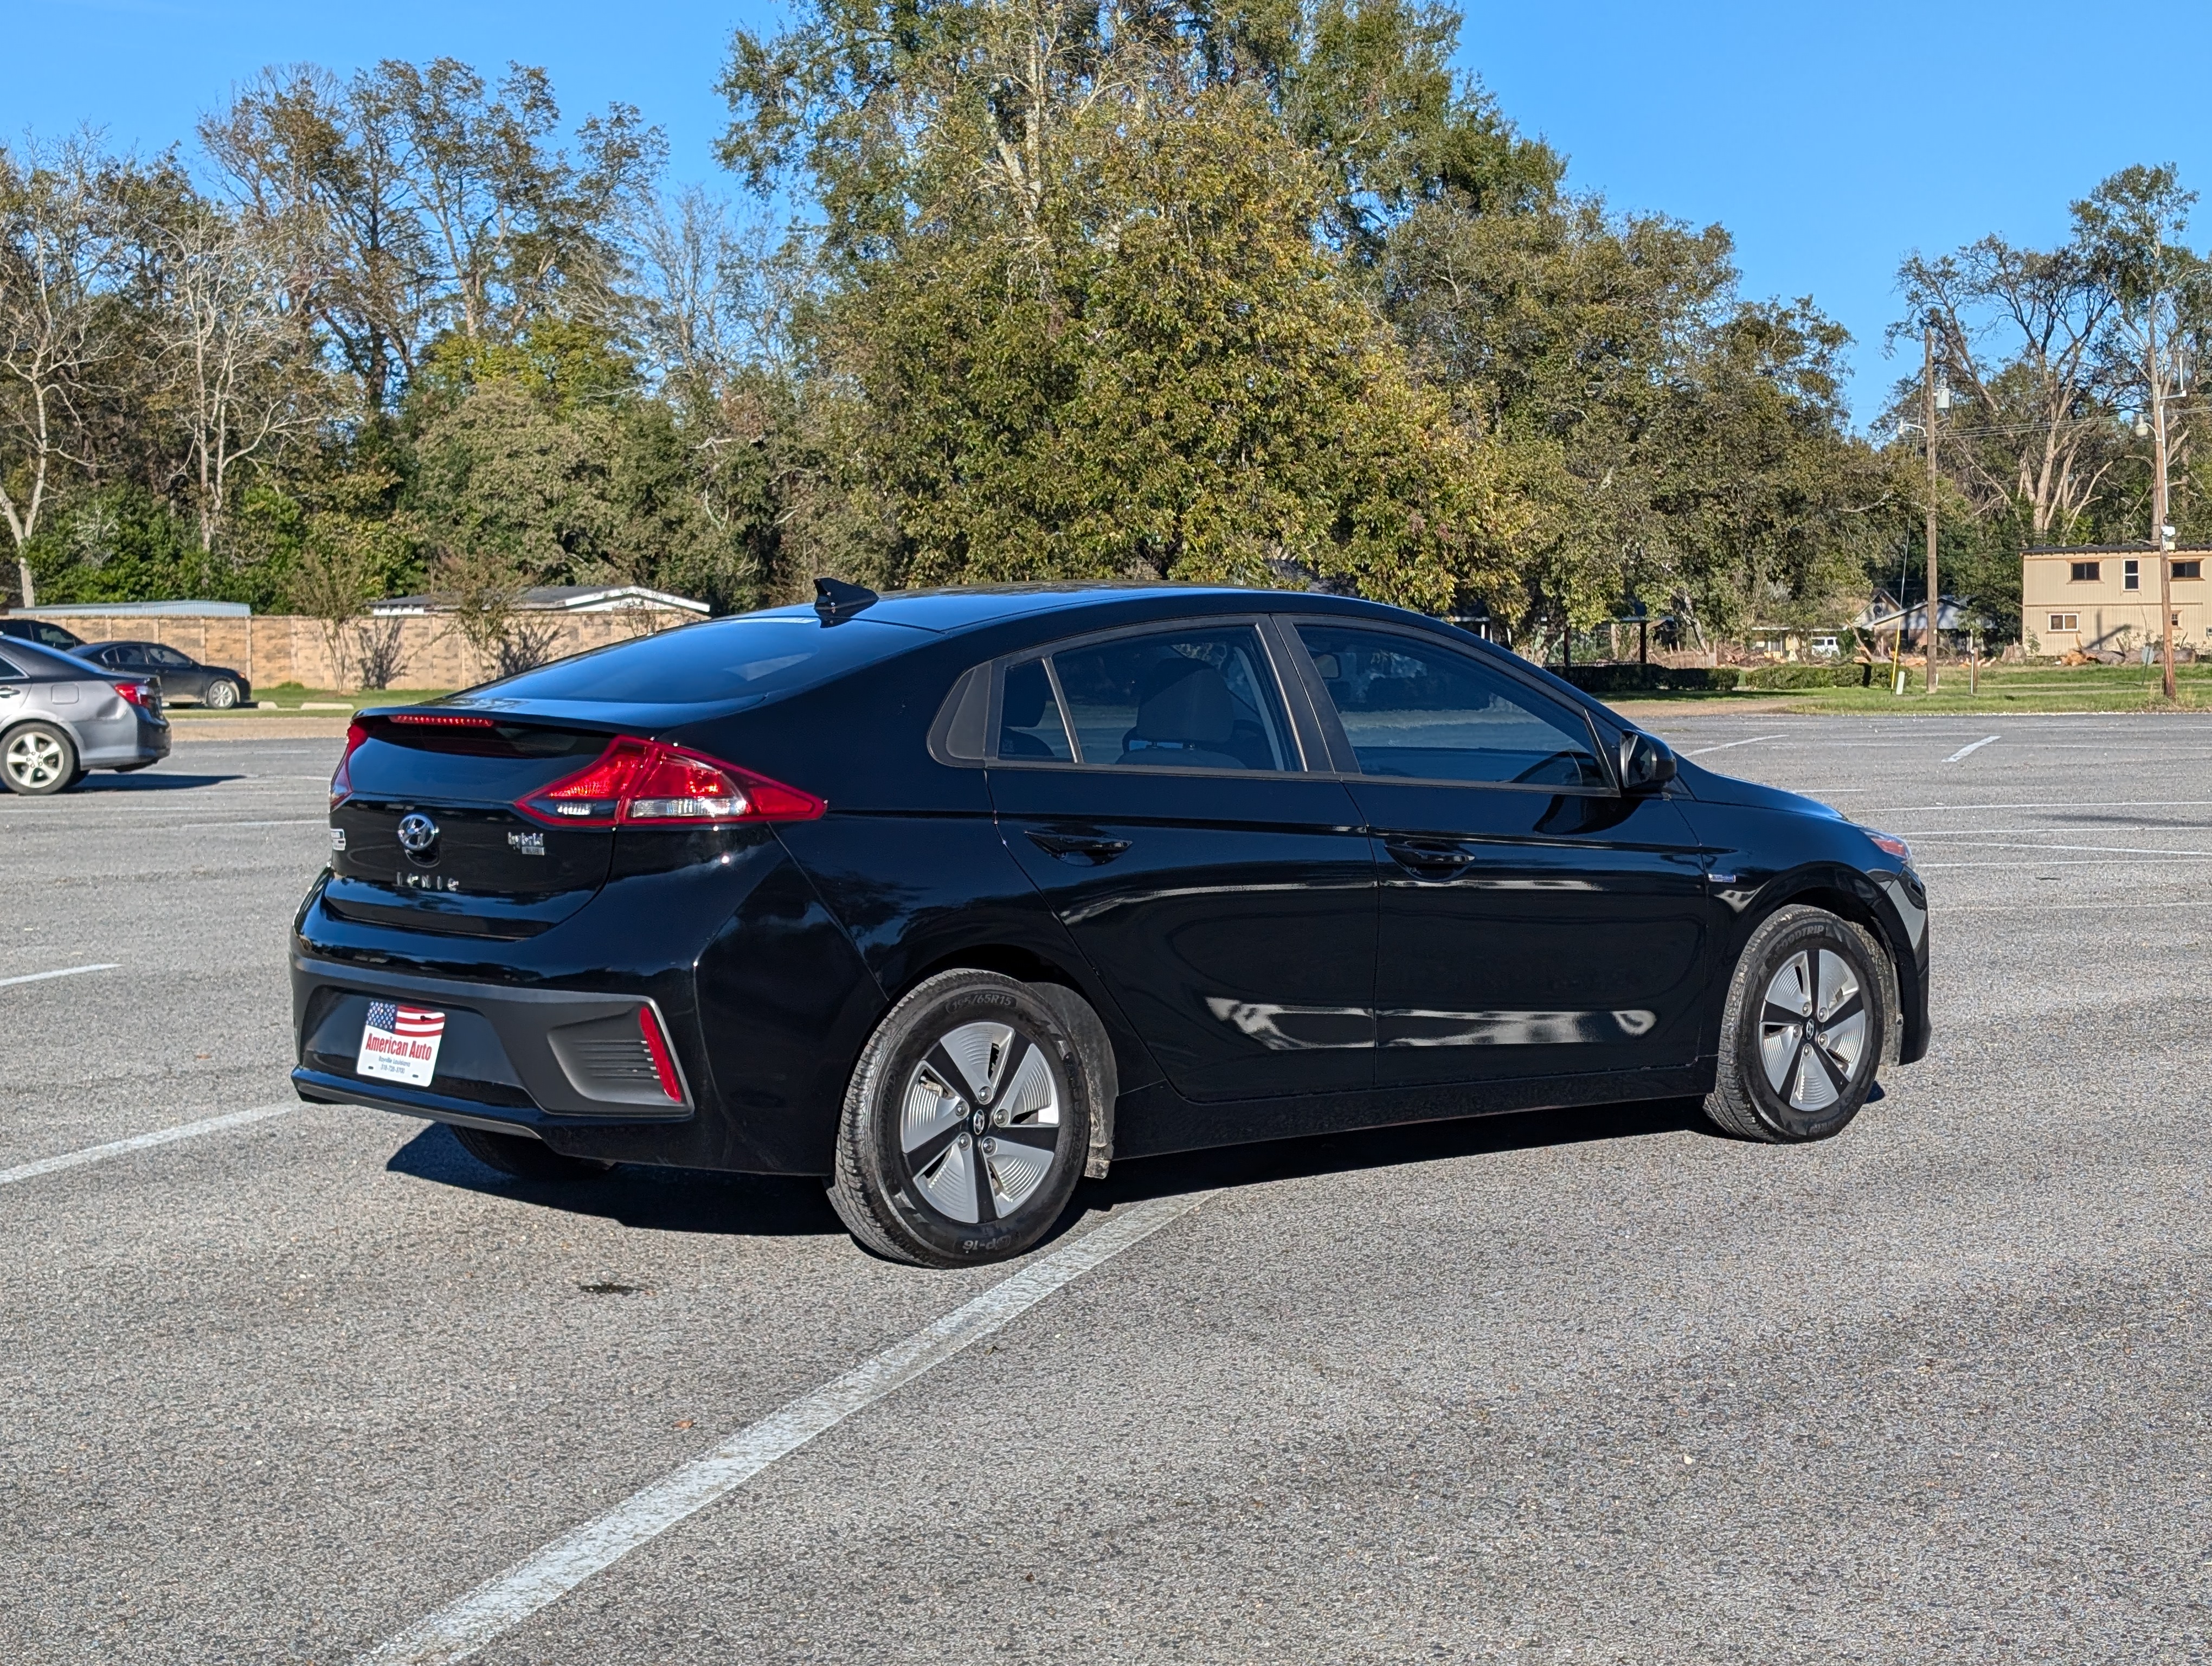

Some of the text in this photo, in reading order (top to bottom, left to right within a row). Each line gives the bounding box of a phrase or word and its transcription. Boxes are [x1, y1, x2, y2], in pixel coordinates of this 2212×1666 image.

[951, 994, 1012, 1010] 195/65R15
[366, 1033, 432, 1060] American Auto
